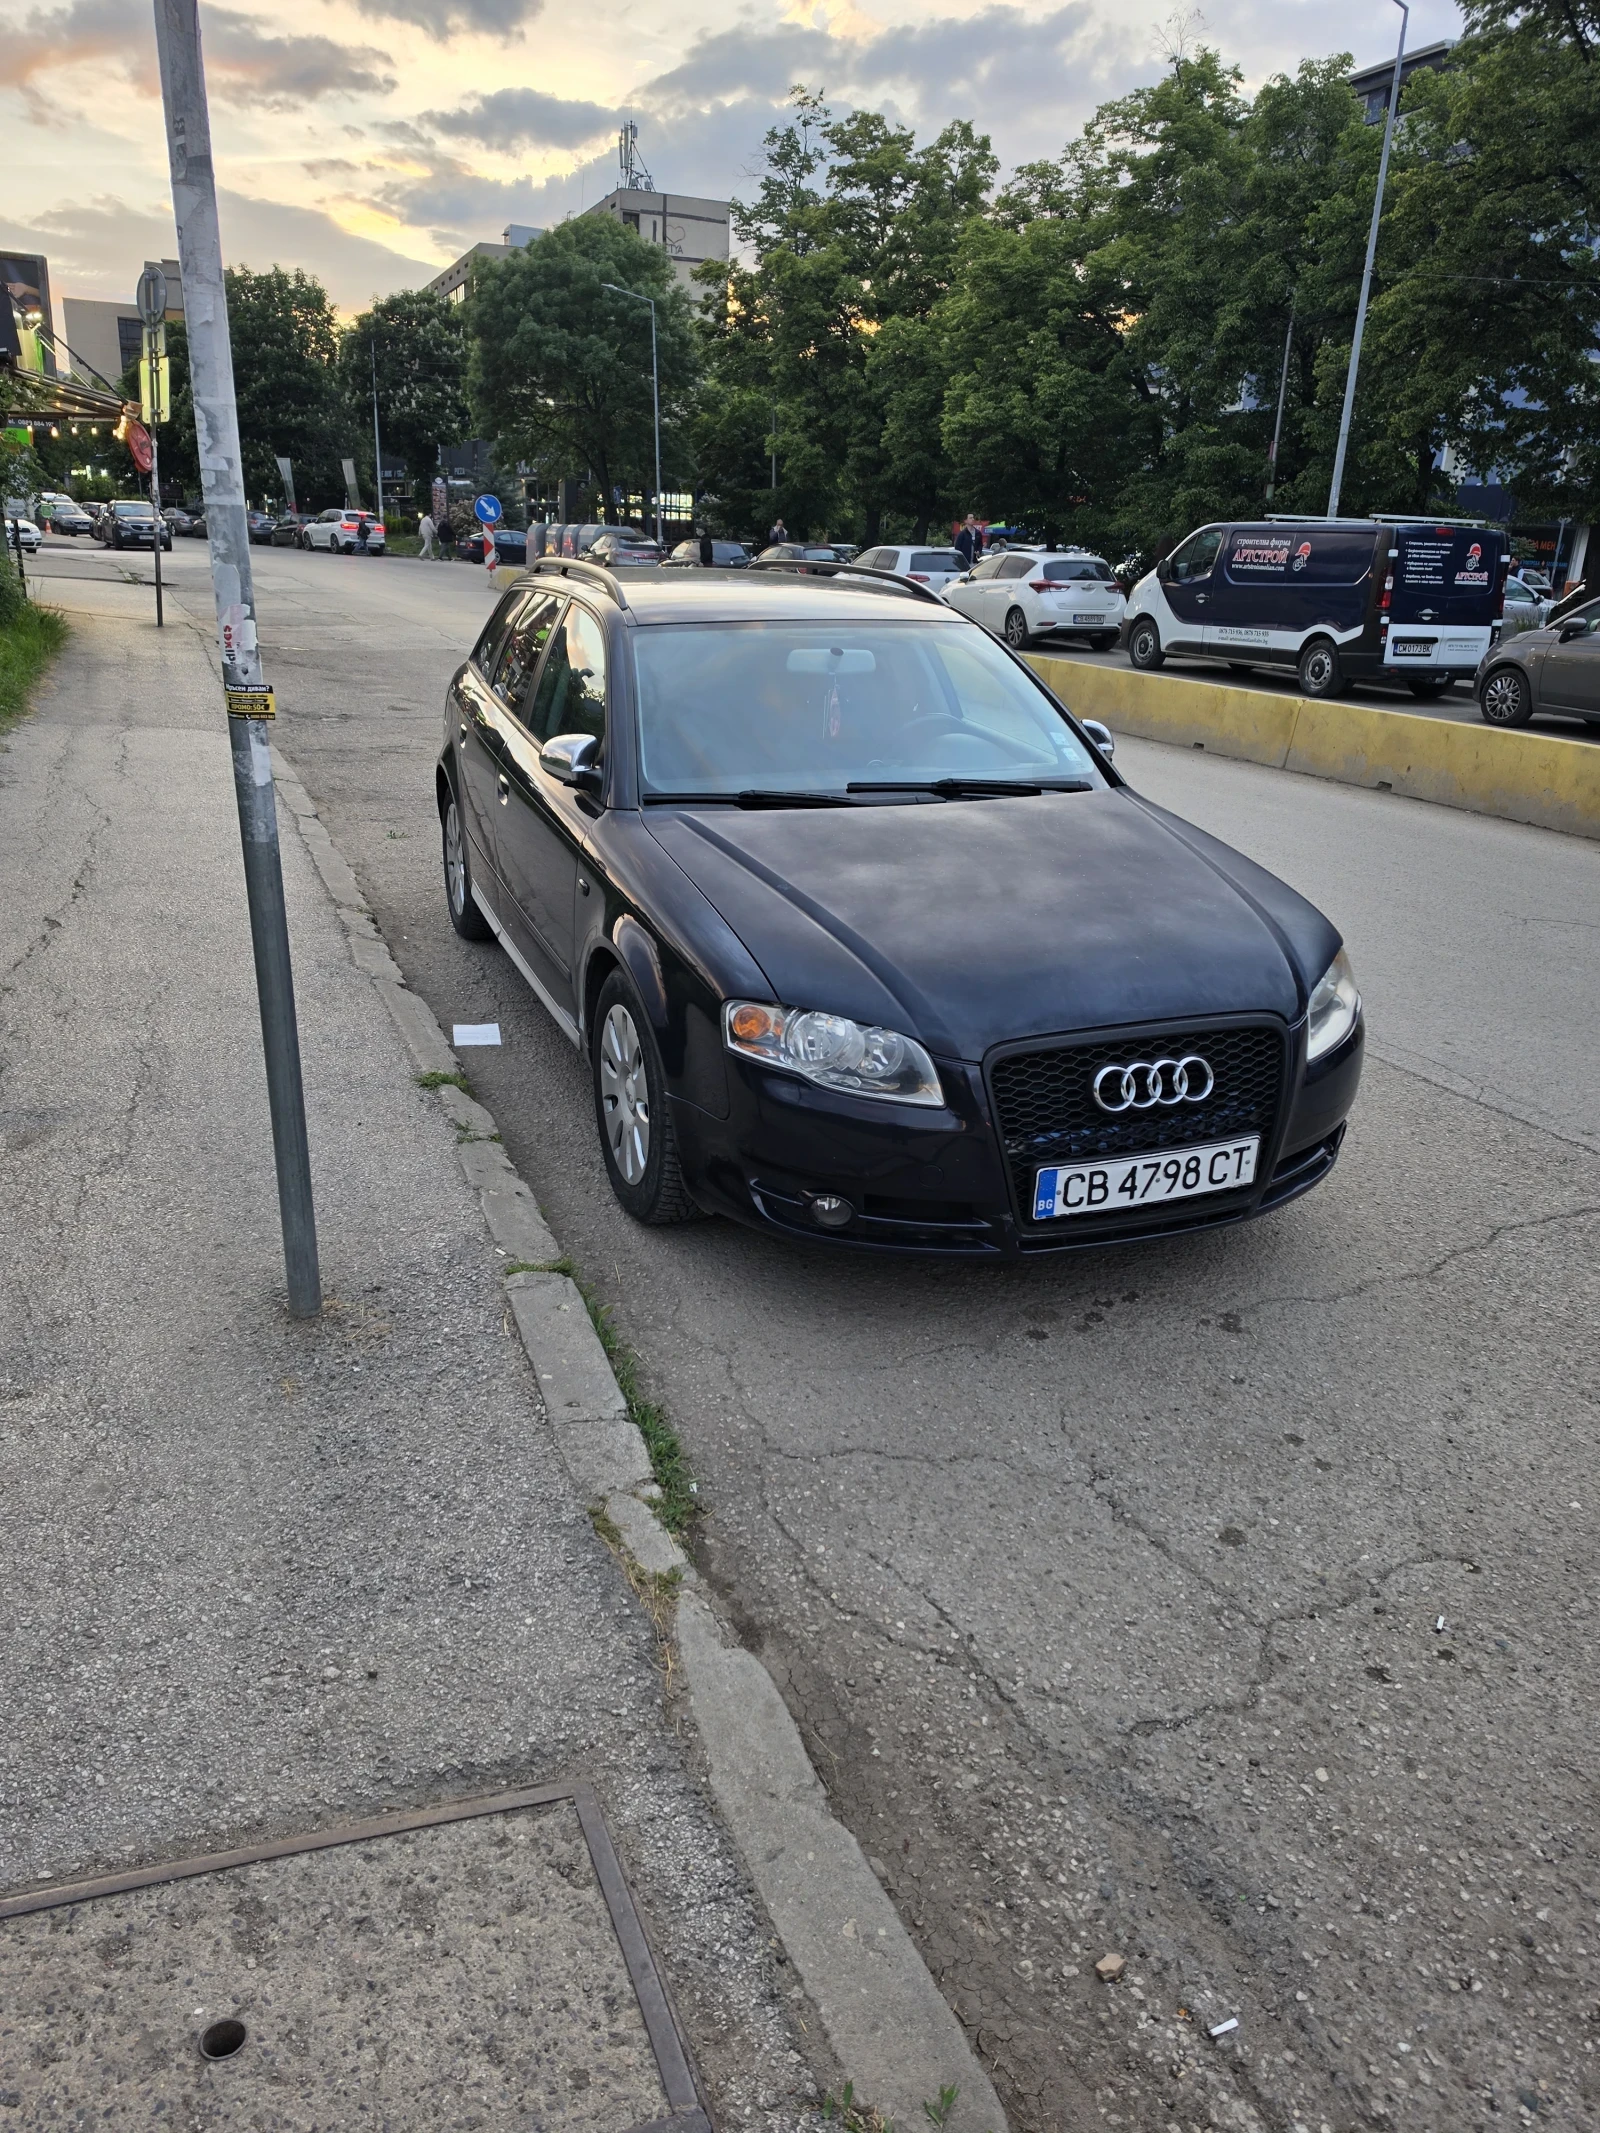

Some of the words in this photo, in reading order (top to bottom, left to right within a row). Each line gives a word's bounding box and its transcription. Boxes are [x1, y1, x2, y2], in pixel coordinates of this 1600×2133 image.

[1237, 538, 1269, 547] строителна
[1270, 538, 1291, 548] фирма
[1232, 548, 1289, 564] АРТСТРОЙ
[1454, 571, 1488, 581] АРТСТРОЙ
[1398, 644, 1407, 653] CM
[1408, 644, 1422, 653] 0173
[1422, 644, 1431, 653] BK
[1062, 1169, 1109, 1208] CB
[1118, 1155, 1200, 1200] 4798
[1208, 1145, 1252, 1185] CT
[1037, 1199, 1053, 1211] BG
